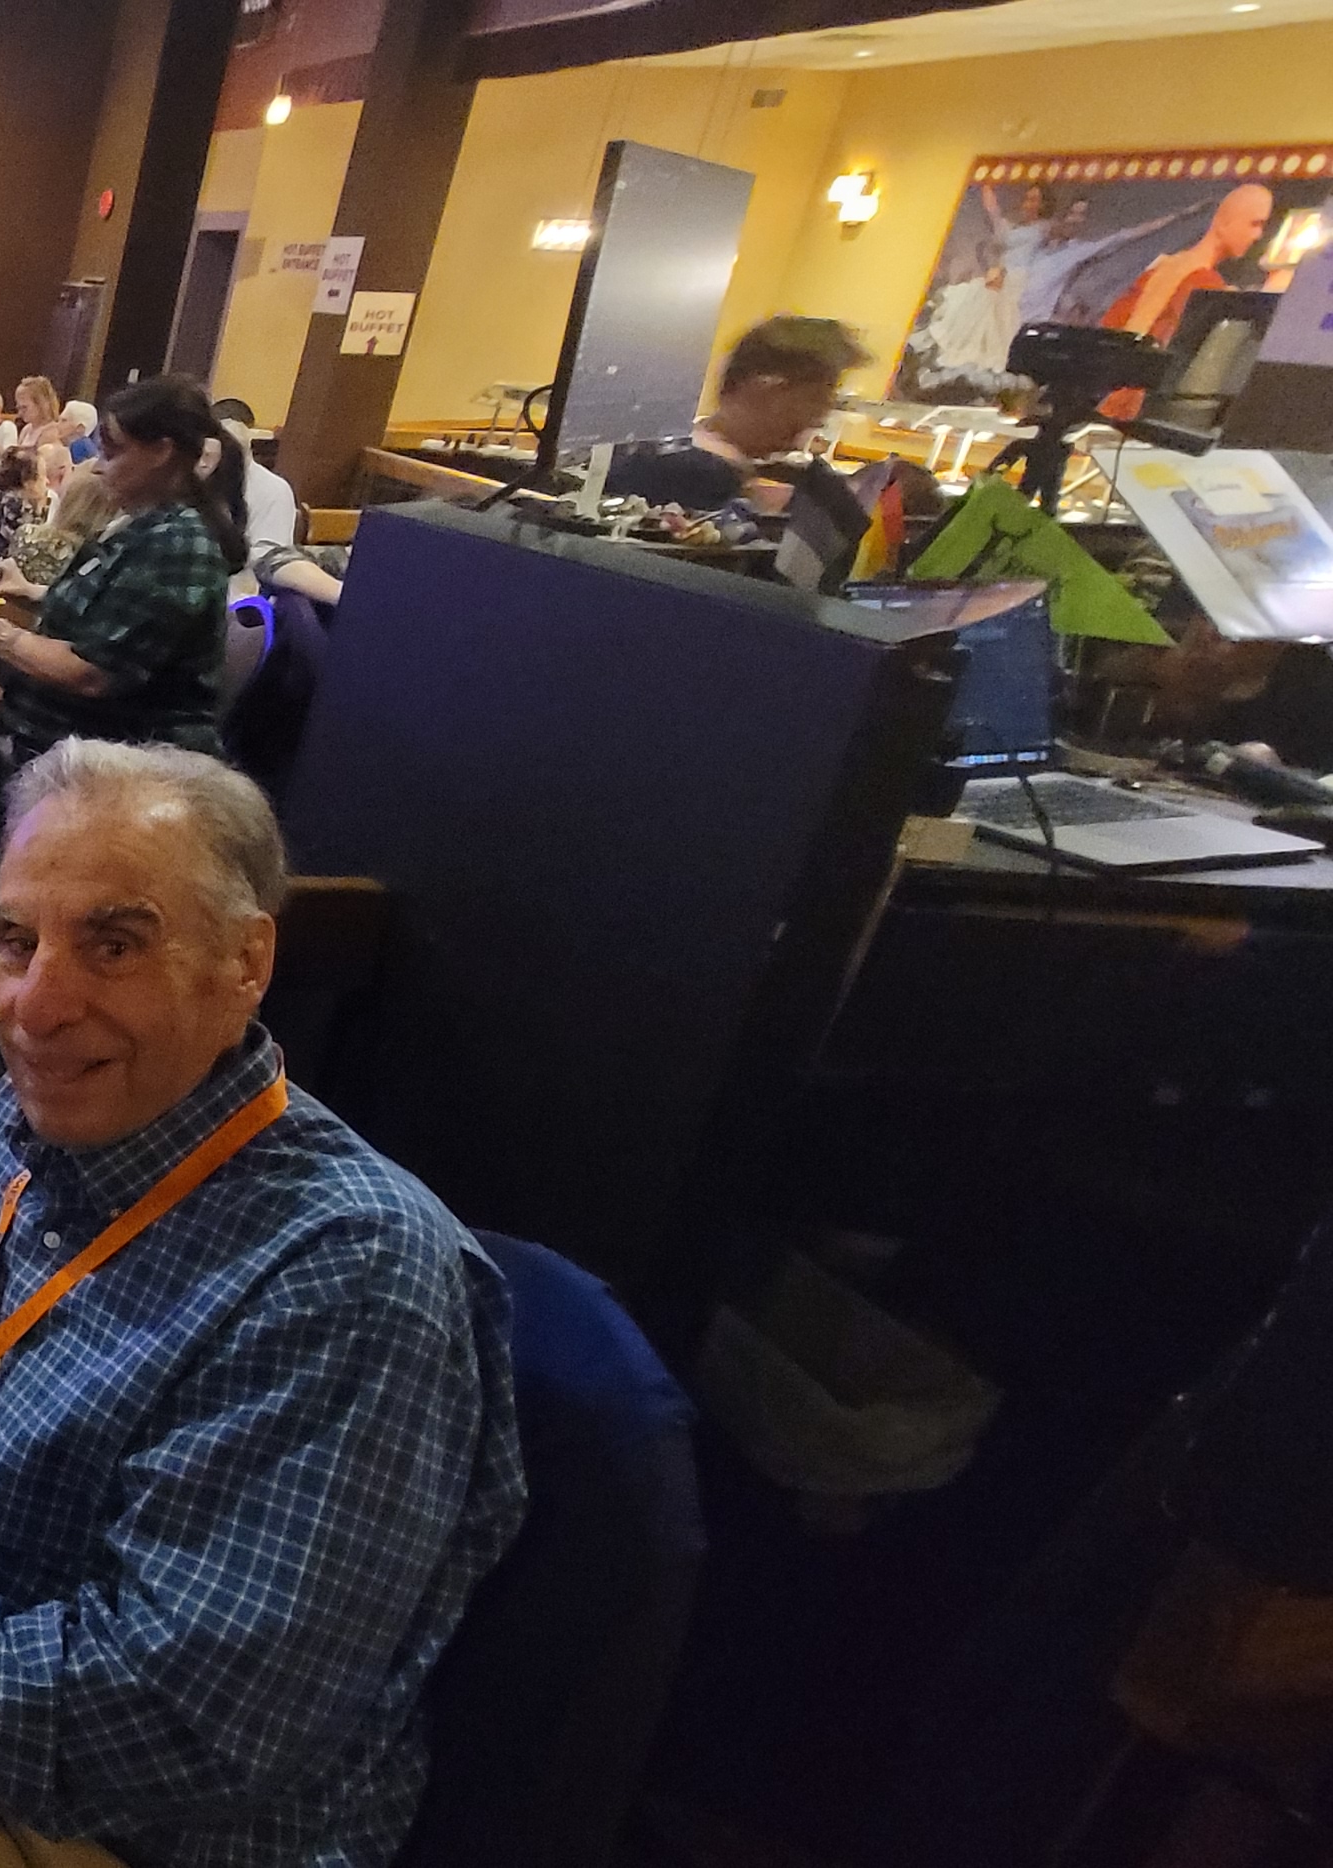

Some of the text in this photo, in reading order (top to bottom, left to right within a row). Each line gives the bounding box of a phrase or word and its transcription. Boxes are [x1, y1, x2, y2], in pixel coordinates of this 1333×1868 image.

[333, 253, 351, 265] HOT
[322, 268, 354, 281] BUFFET
[364, 310, 395, 320] HOT
[349, 323, 405, 334] BUFFET
